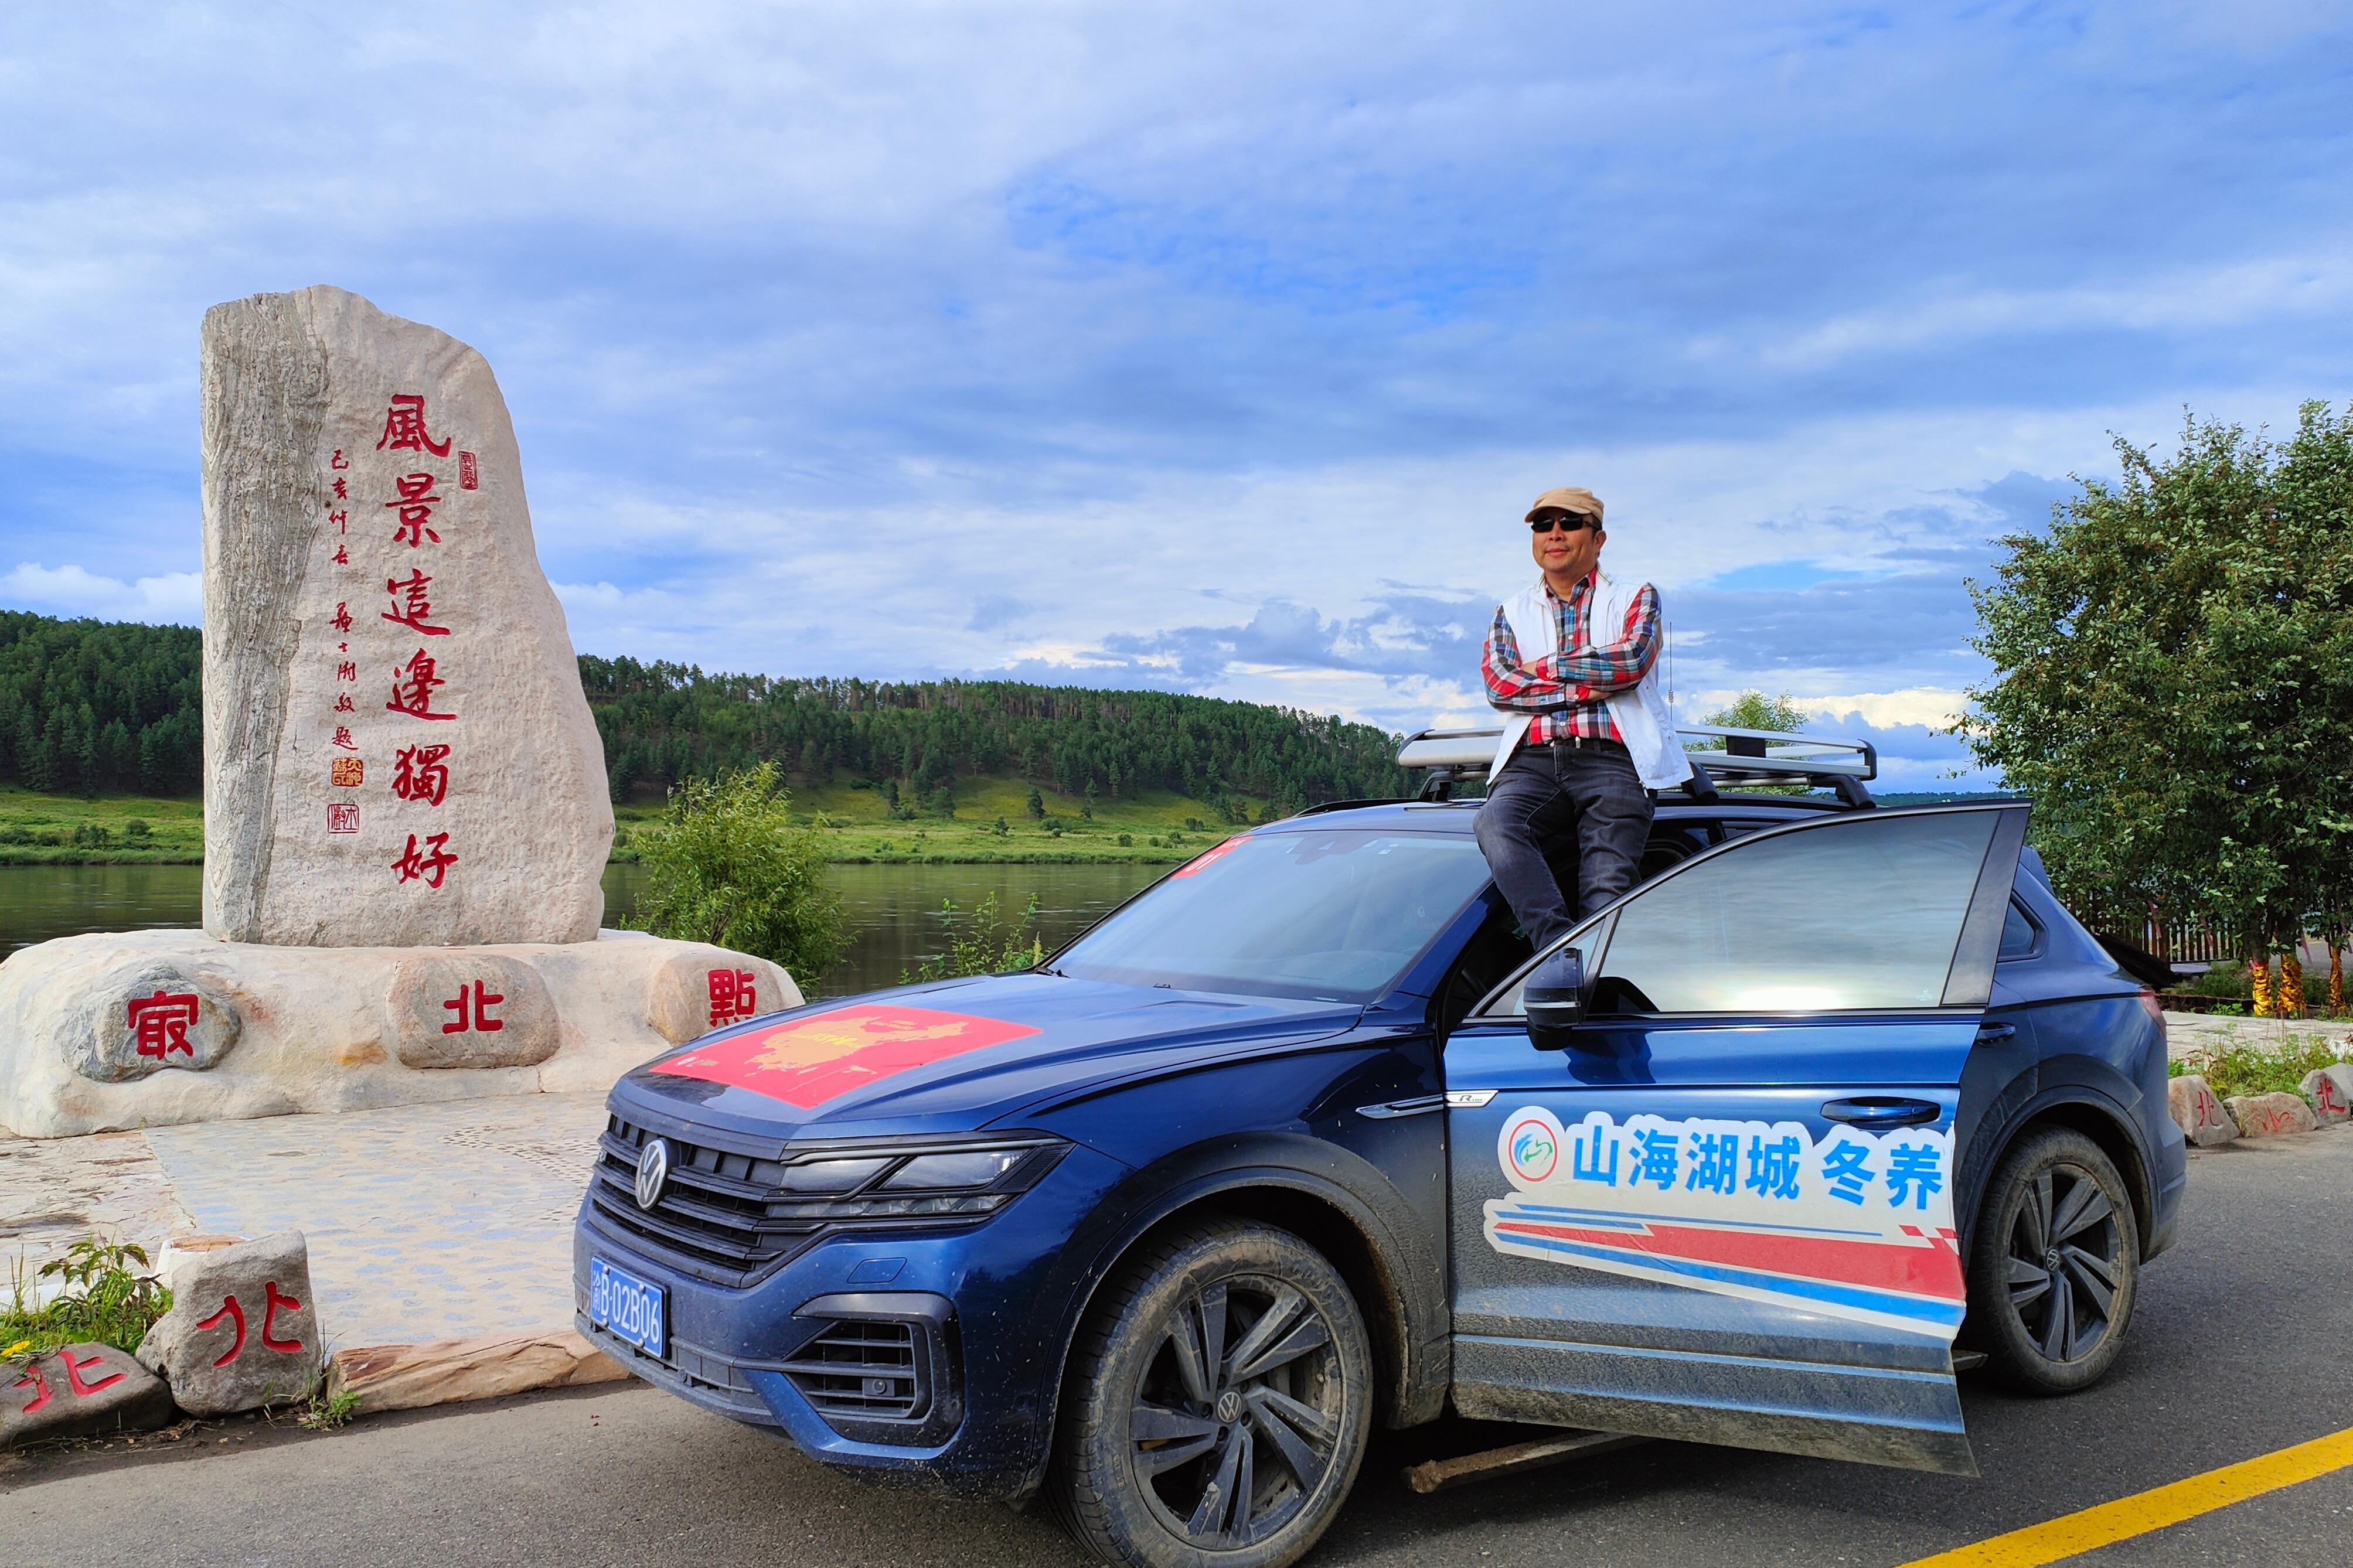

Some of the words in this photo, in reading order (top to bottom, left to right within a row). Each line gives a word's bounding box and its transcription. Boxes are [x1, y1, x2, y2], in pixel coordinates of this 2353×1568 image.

[377, 394, 458, 889] 風景這邊獨好
[442, 979, 504, 1035] 北
[1572, 1124, 1800, 1200] 山海湖城
[1821, 1138, 1943, 1210] 冬养
[196, 1281, 303, 1368] 北
[13, 1351, 127, 1413] 北
